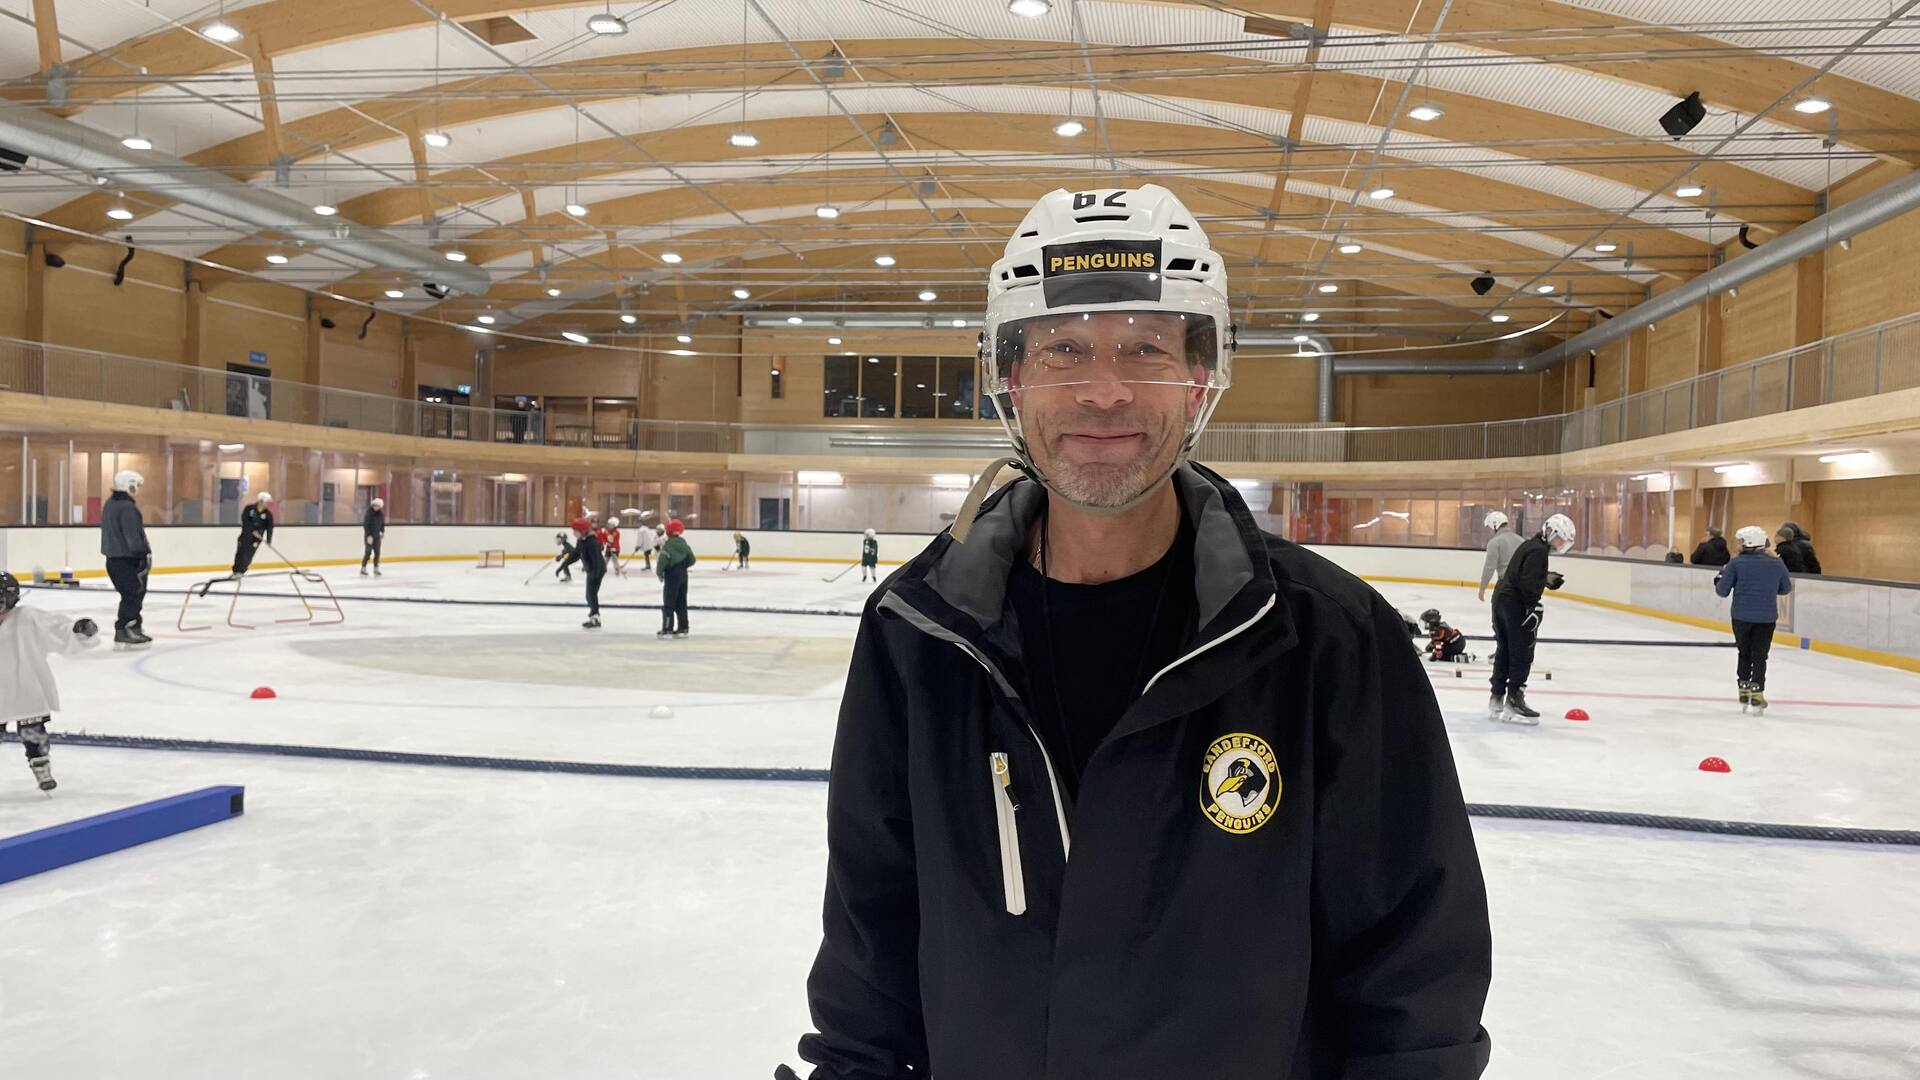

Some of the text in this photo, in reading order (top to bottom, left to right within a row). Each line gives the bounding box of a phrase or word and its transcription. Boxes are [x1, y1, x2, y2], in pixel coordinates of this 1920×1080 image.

[1050, 253, 1155, 272] PENGUINS
[1203, 736, 1276, 774] SANDEFJORD
[1207, 803, 1272, 830] PENGUINS
